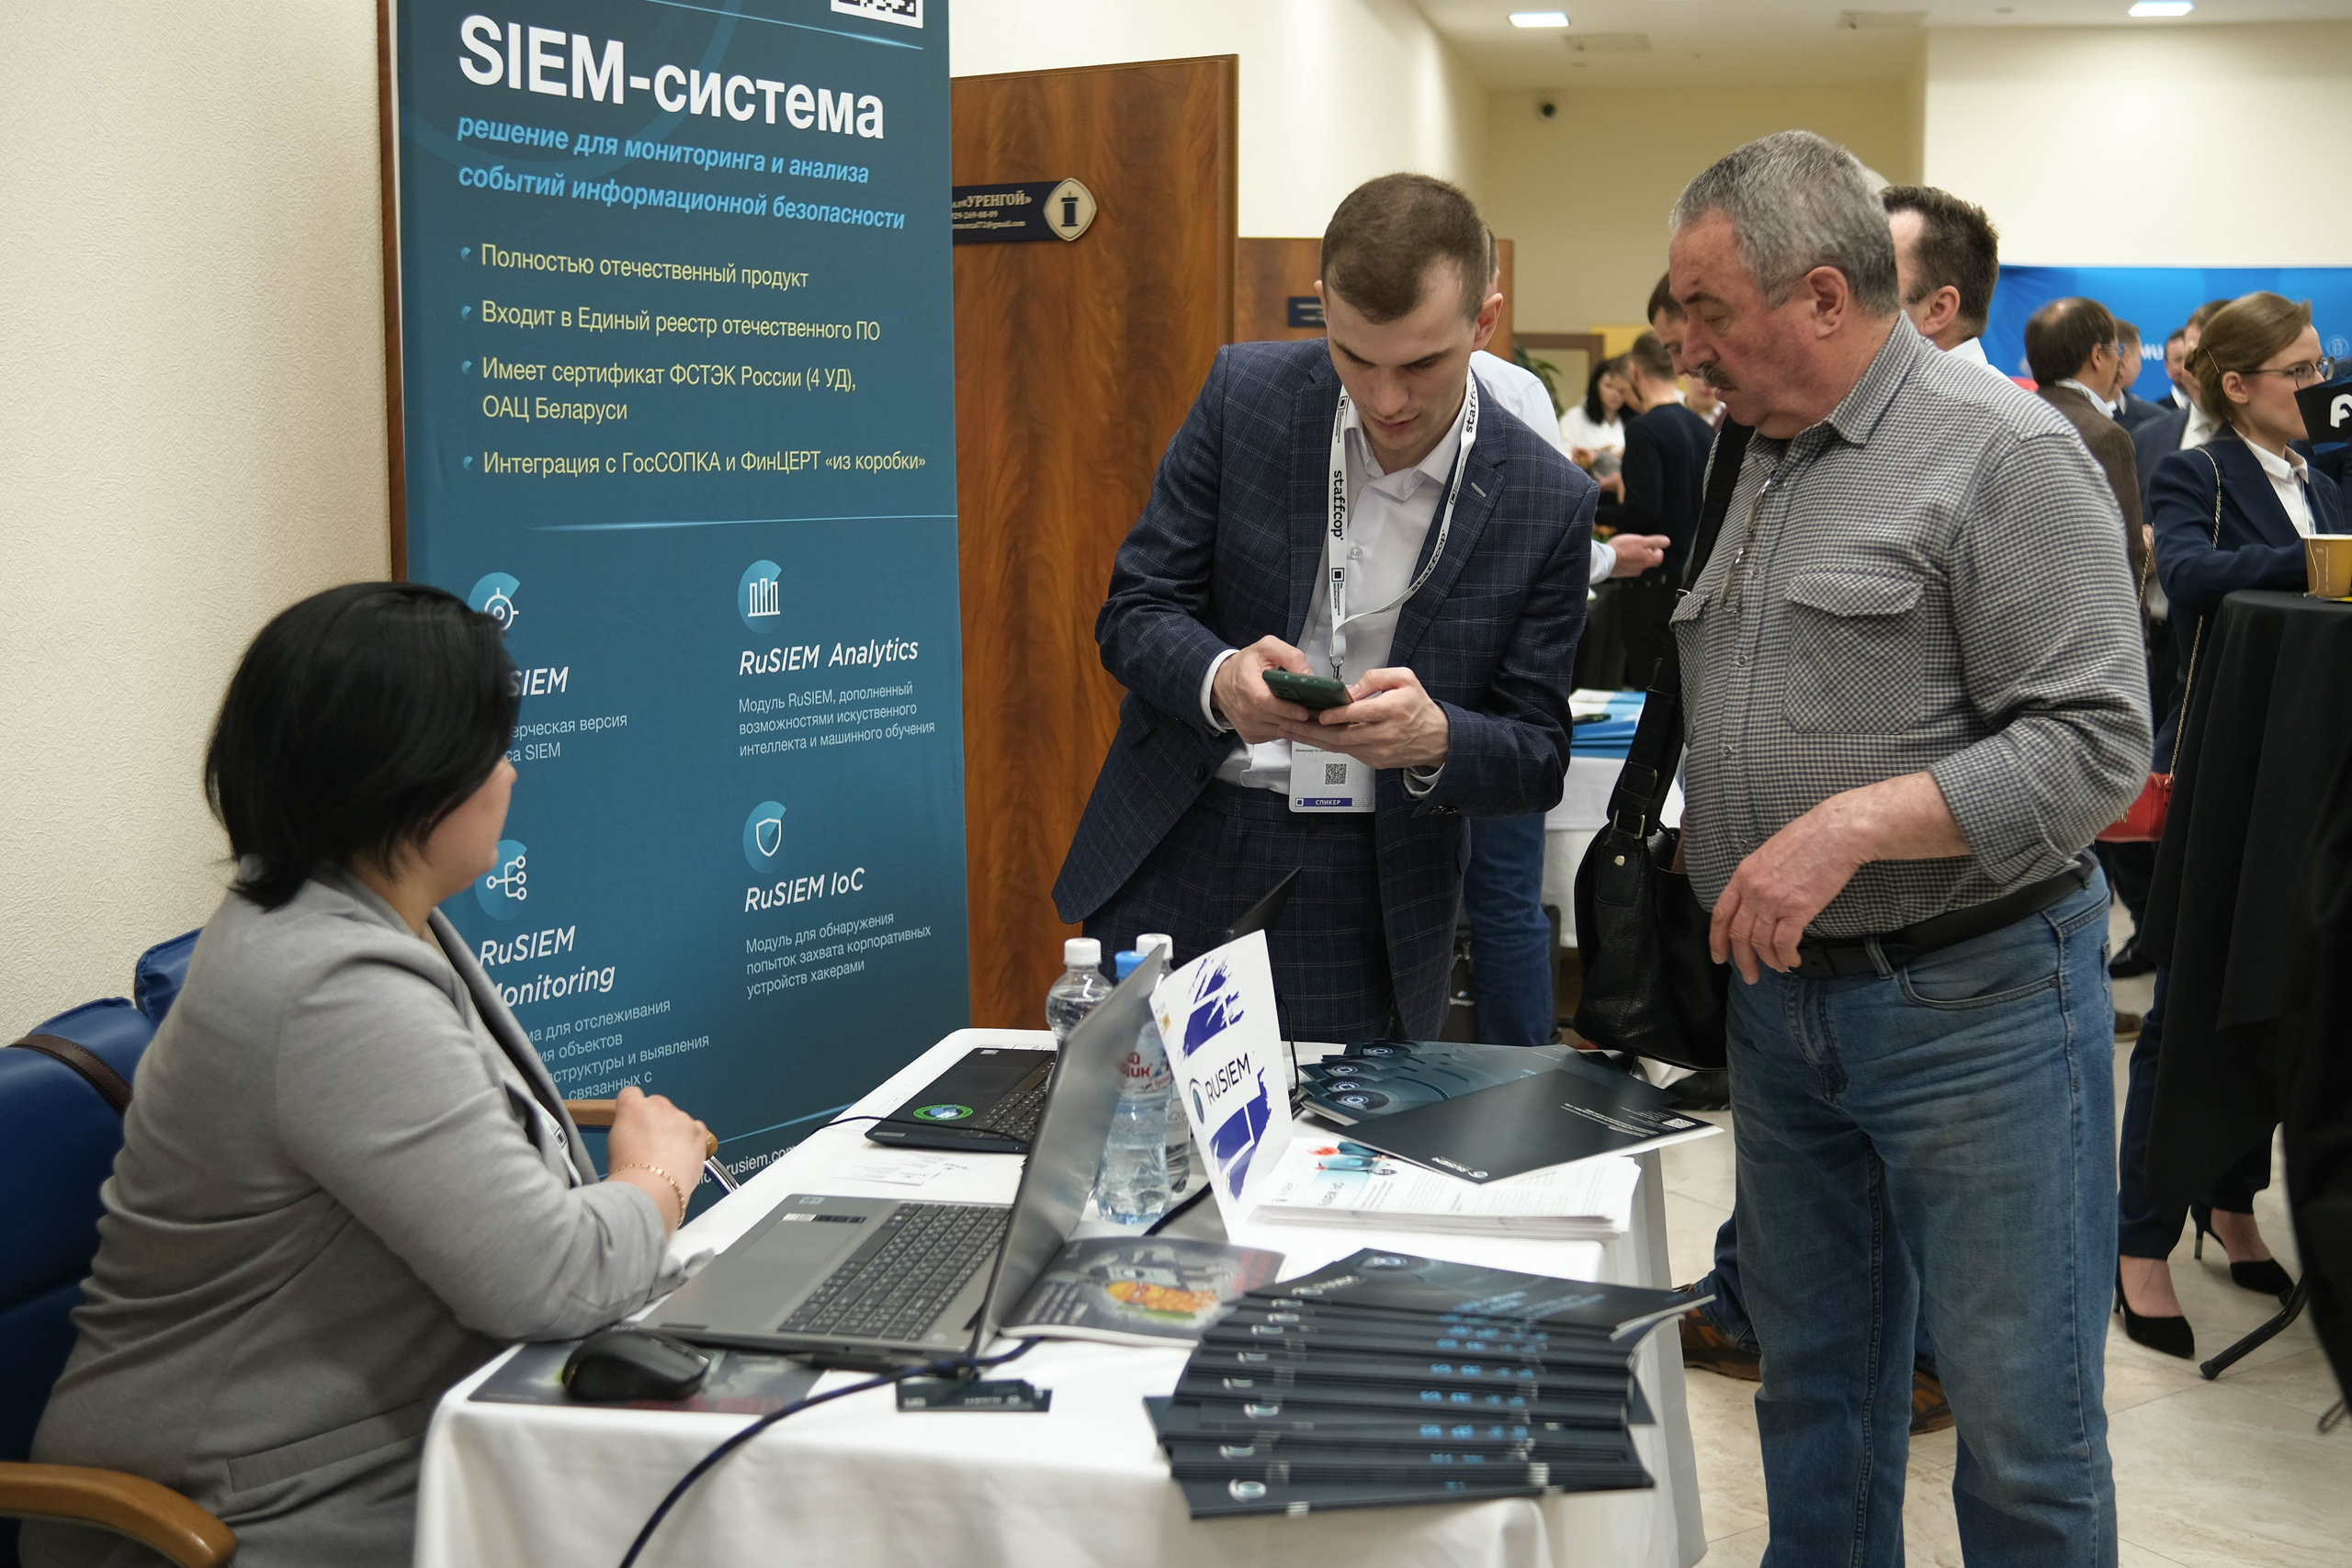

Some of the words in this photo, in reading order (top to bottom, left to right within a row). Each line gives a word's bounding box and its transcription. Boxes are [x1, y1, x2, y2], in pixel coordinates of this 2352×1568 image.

[459, 15, 885, 139] SIEM-система
[457, 116, 569, 150] решение
[573, 131, 618, 157] для
[625, 139, 766, 173] мониторинга
[771, 157, 785, 174] и
[788, 158, 870, 184] анализа
[458, 164, 566, 197] событий
[571, 179, 768, 216] информационной
[772, 195, 905, 231] безопасности
[481, 244, 594, 275] Полностью
[600, 257, 737, 284] отечественный
[741, 269, 809, 290] продукт
[481, 301, 555, 328] Входит
[561, 310, 572, 326] в
[578, 307, 650, 332] Единый
[655, 313, 718, 339] реестр
[722, 318, 852, 340] отечественного
[856, 321, 880, 342] ПО
[482, 357, 547, 382] Имеет
[551, 361, 665, 389] сертификат
[669, 364, 736, 386] ФСТЭК
[741, 366, 802, 387] России
[806, 367, 820, 389] (4
[825, 368, 856, 392] УД),
[482, 395, 529, 423] ОАЦ
[535, 397, 628, 424] Беларуси
[482, 451, 600, 478] Интеграция
[605, 458, 616, 474] с
[622, 451, 721, 474] ГосСОПКА
[726, 457, 736, 471] и
[740, 451, 820, 474] ФинЦЕРТ
[824, 456, 852, 470] «из
[854, 451, 926, 473] коробки»
[1331, 469, 1345, 540] staffcop
[739, 645, 820, 676] RuSIEM
[828, 637, 919, 668] Analytics
[507, 666, 570, 696] SIEM
[739, 698, 786, 715] Модуль
[788, 689, 836, 708] RuSIEM,
[838, 681, 913, 705] дополненный
[511, 720, 576, 741] ерческая
[580, 715, 628, 733] версия
[739, 713, 834, 735] возможностями
[837, 704, 917, 724] искуственного
[740, 737, 807, 757] интеллекта
[809, 736, 818, 748] и
[820, 728, 883, 746] машинного
[885, 721, 935, 740] обучения
[526, 741, 560, 761] SIEM
[744, 874, 825, 912] RuSIEM
[831, 867, 865, 896] IoC
[480, 925, 576, 966] RuSIEM
[746, 934, 793, 953] Модуль
[795, 930, 817, 946] для
[819, 913, 894, 938] обнаружения
[746, 953, 797, 976] попыток
[799, 944, 844, 963] захвата
[846, 925, 932, 953] корпоративных
[746, 974, 808, 1000] устройств
[810, 960, 865, 983] хакерами
[546, 1021, 571, 1041] для
[574, 1000, 672, 1032] отслеживания
[551, 1055, 625, 1084] структуры
[628, 1052, 637, 1066] и
[639, 1035, 710, 1063] выявления
[559, 1033, 624, 1059] объектов
[569, 1073, 641, 1100] связанных
[644, 1070, 652, 1084] с
[1205, 1053, 1251, 1105] RUSIEM
